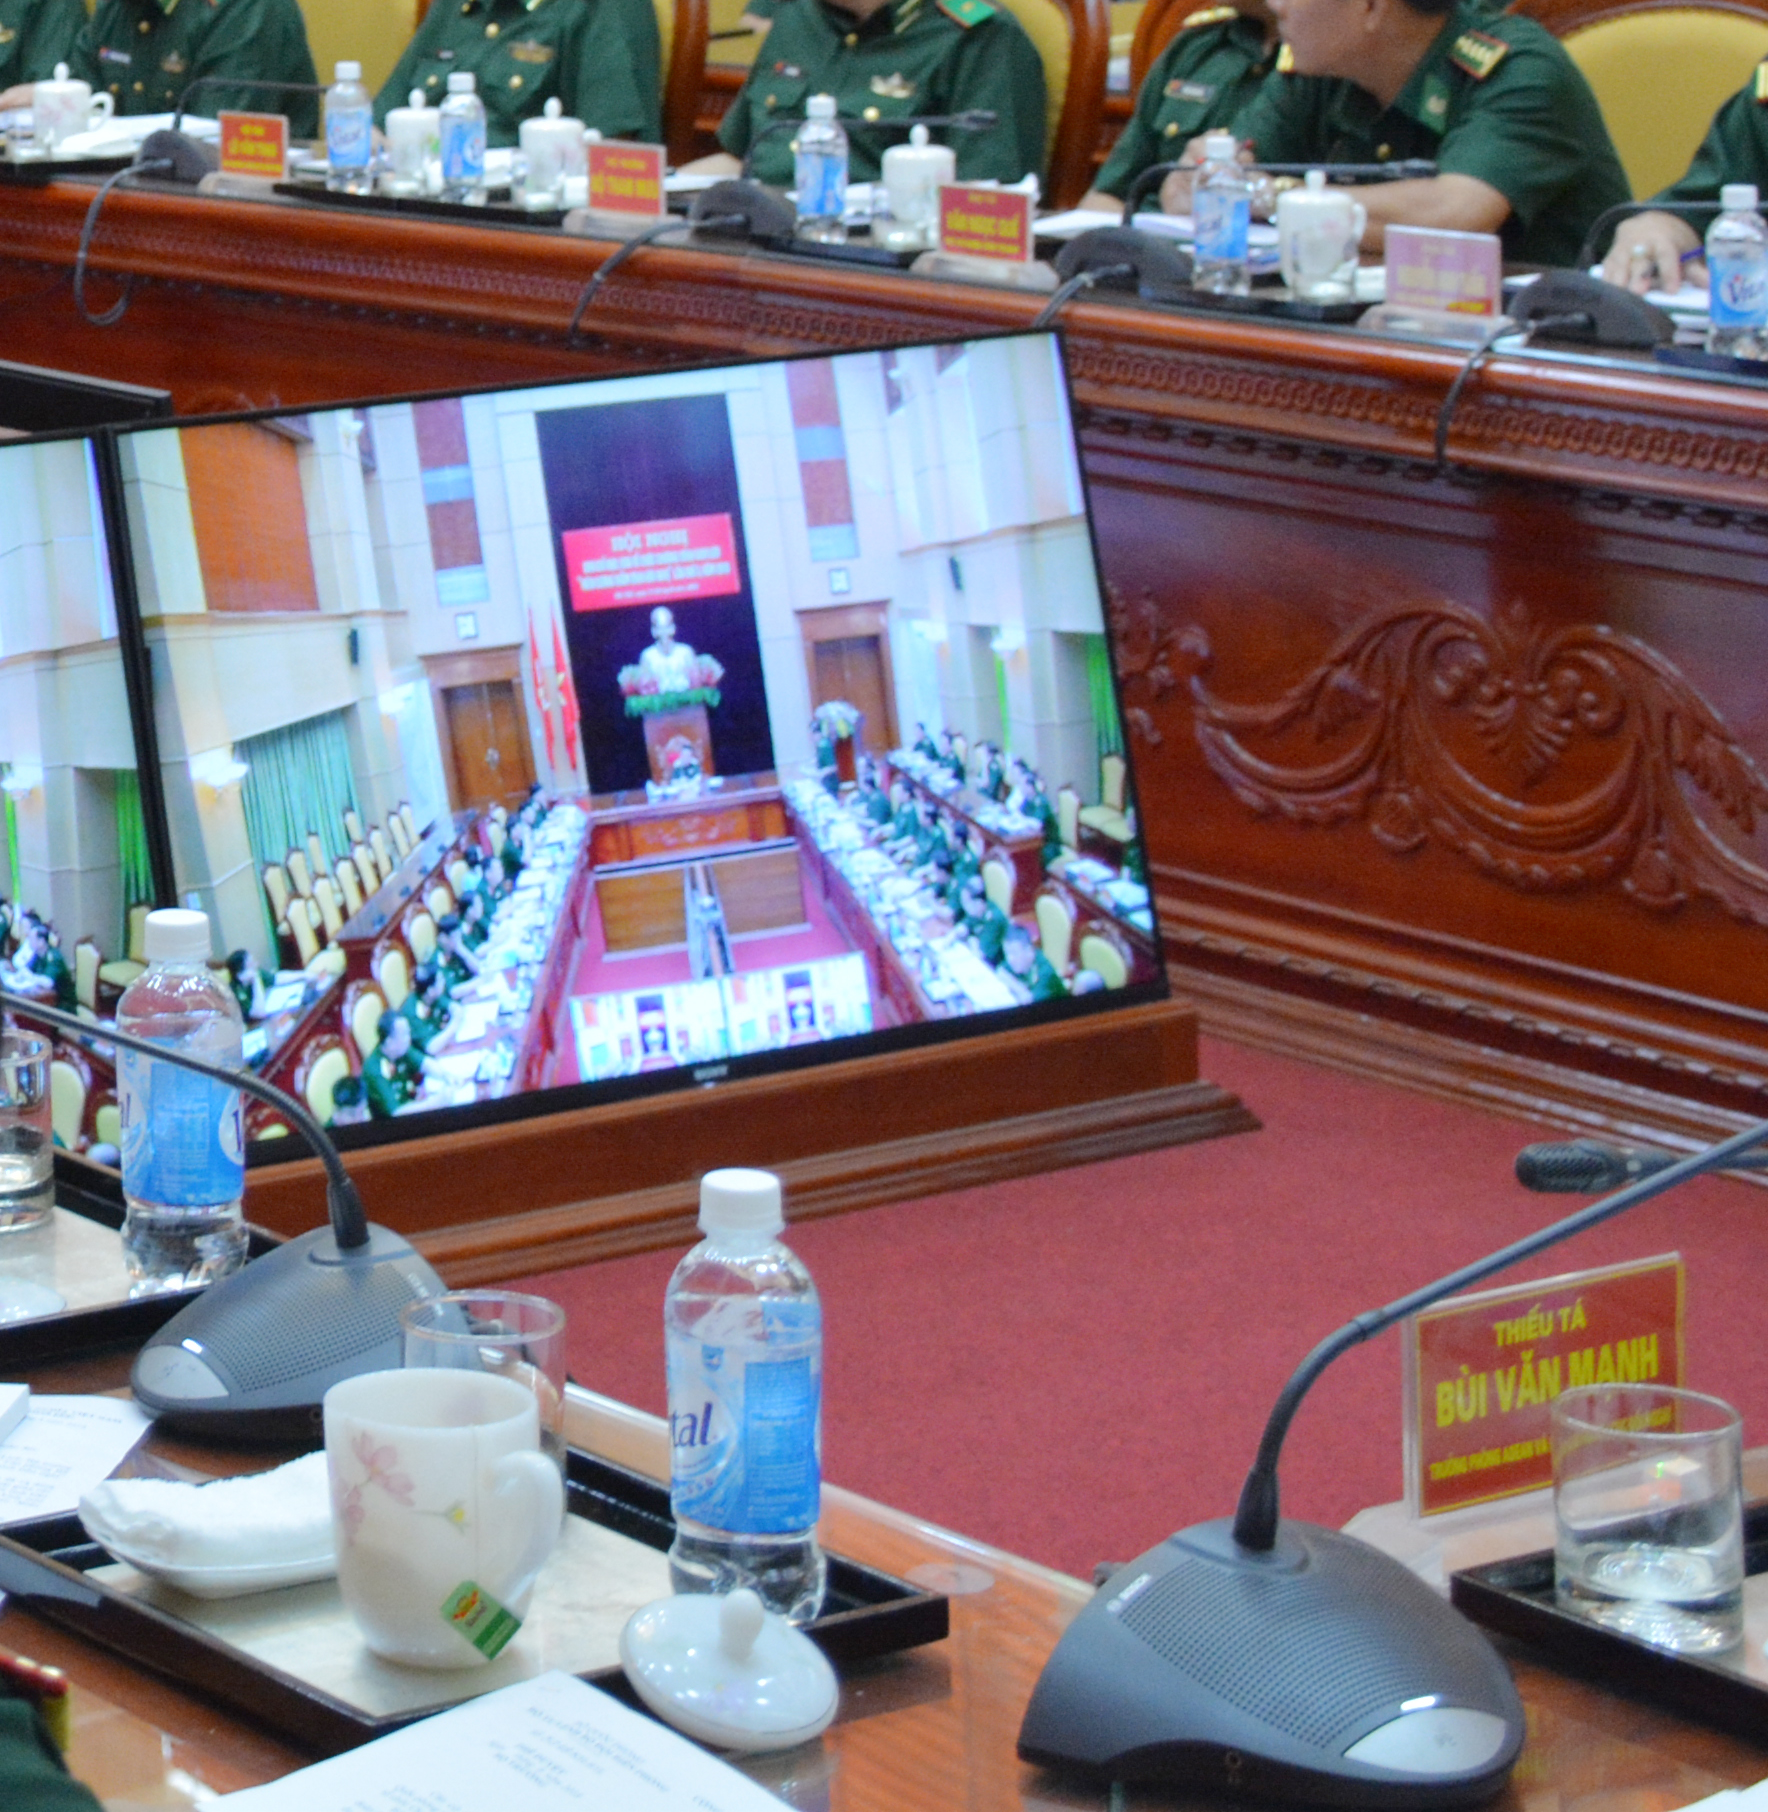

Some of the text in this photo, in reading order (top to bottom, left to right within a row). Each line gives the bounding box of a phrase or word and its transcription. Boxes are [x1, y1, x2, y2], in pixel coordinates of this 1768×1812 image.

[1494, 1297, 1587, 1347] THIẾU TÁ
[1435, 1363, 1488, 1428] BÙI
[1495, 1348, 1561, 1413] VĂN
